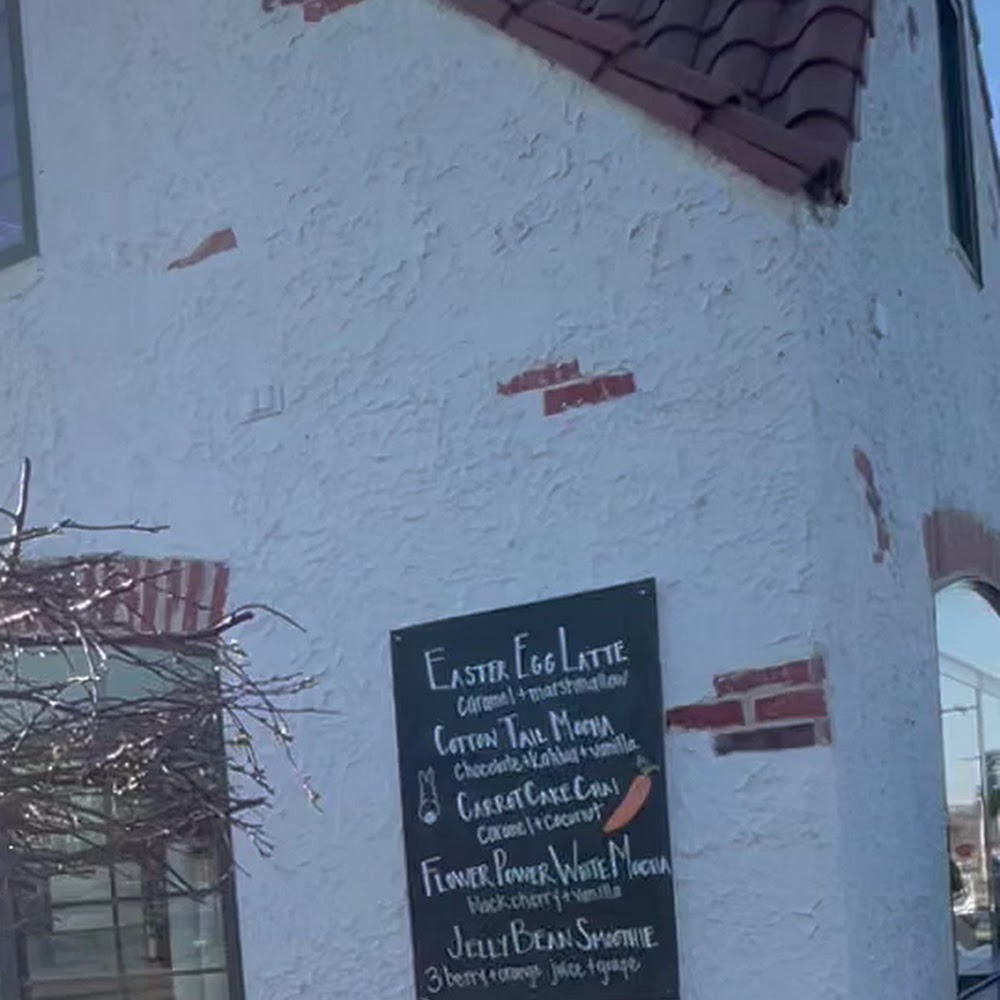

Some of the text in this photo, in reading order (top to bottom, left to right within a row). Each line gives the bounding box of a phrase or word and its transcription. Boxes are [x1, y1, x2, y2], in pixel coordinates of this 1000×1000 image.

[425, 626, 628, 689] EASTER EGG LATTE
[434, 710, 615, 756] COTTON TAIL MOCHA
[457, 775, 620, 822] CARROT CAKE CHAI
[421, 833, 672, 897] FLOWER POWER WHITE MOCHA
[446, 917, 659, 959] JELLY BEAN SMOOTHIE
[423, 966, 442, 994] 3
